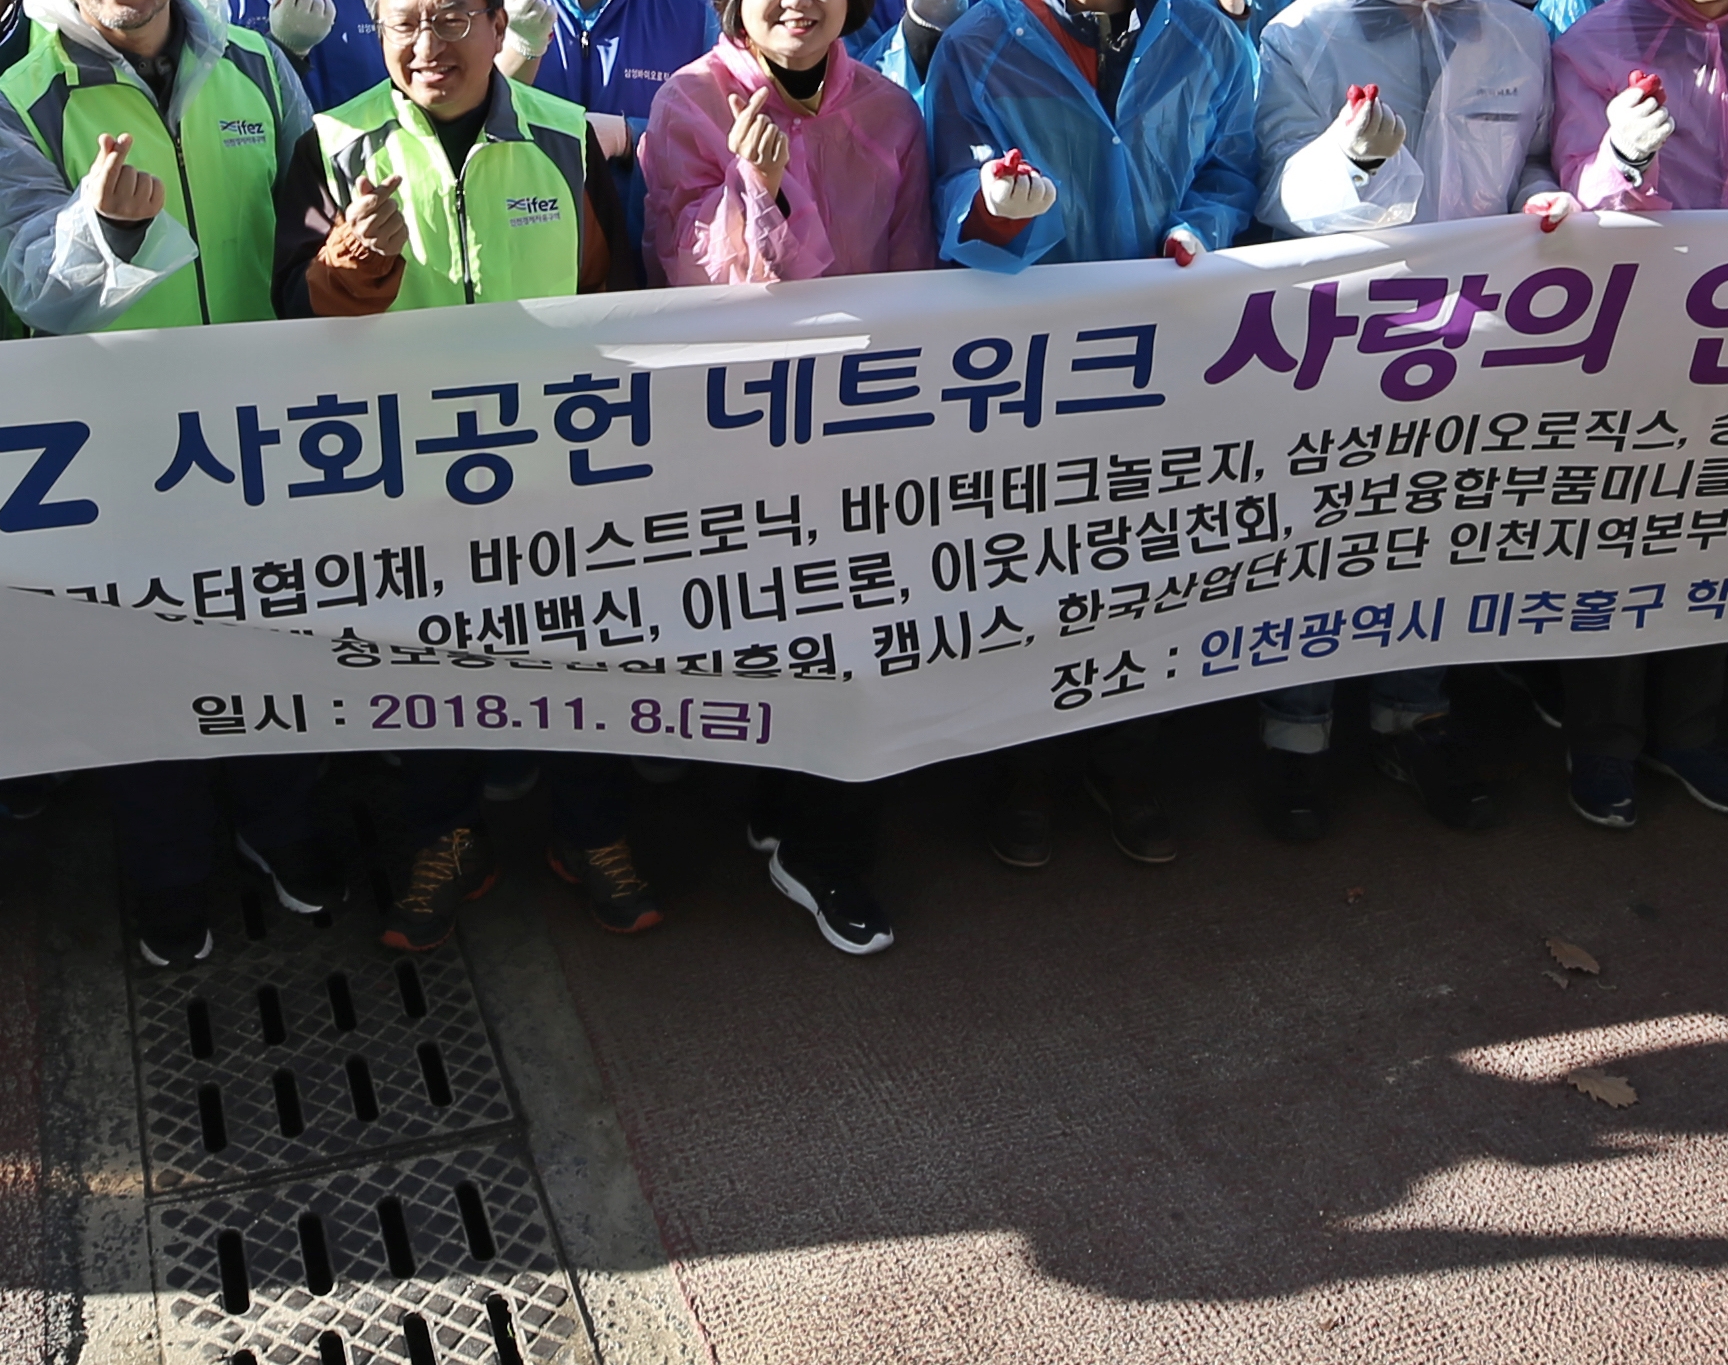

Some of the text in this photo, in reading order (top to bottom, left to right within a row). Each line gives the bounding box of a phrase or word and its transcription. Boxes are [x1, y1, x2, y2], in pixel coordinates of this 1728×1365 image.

[152, 370, 656, 507] 사회공헌
[705, 322, 1167, 447] 네트워크
[1204, 262, 1639, 403] 사랑의
[469, 494, 818, 586] 바이스트로닉,
[841, 439, 1265, 535] 바이텍테크놀로지,
[1286, 409, 1689, 477] 삼성바이오로직스,
[682, 551, 911, 631] 이너트론,
[930, 491, 1293, 594] 이웃사랑실천회,
[871, 604, 1036, 677] 캠시스,
[1057, 525, 1430, 637] 한국산업단지공단
[1049, 648, 1147, 711] 장소
[1199, 596, 1446, 678] 인천광역시
[1466, 582, 1667, 637] 미추홀구
[191, 692, 308, 736] 일시
[368, 693, 607, 731] 2018.11.
